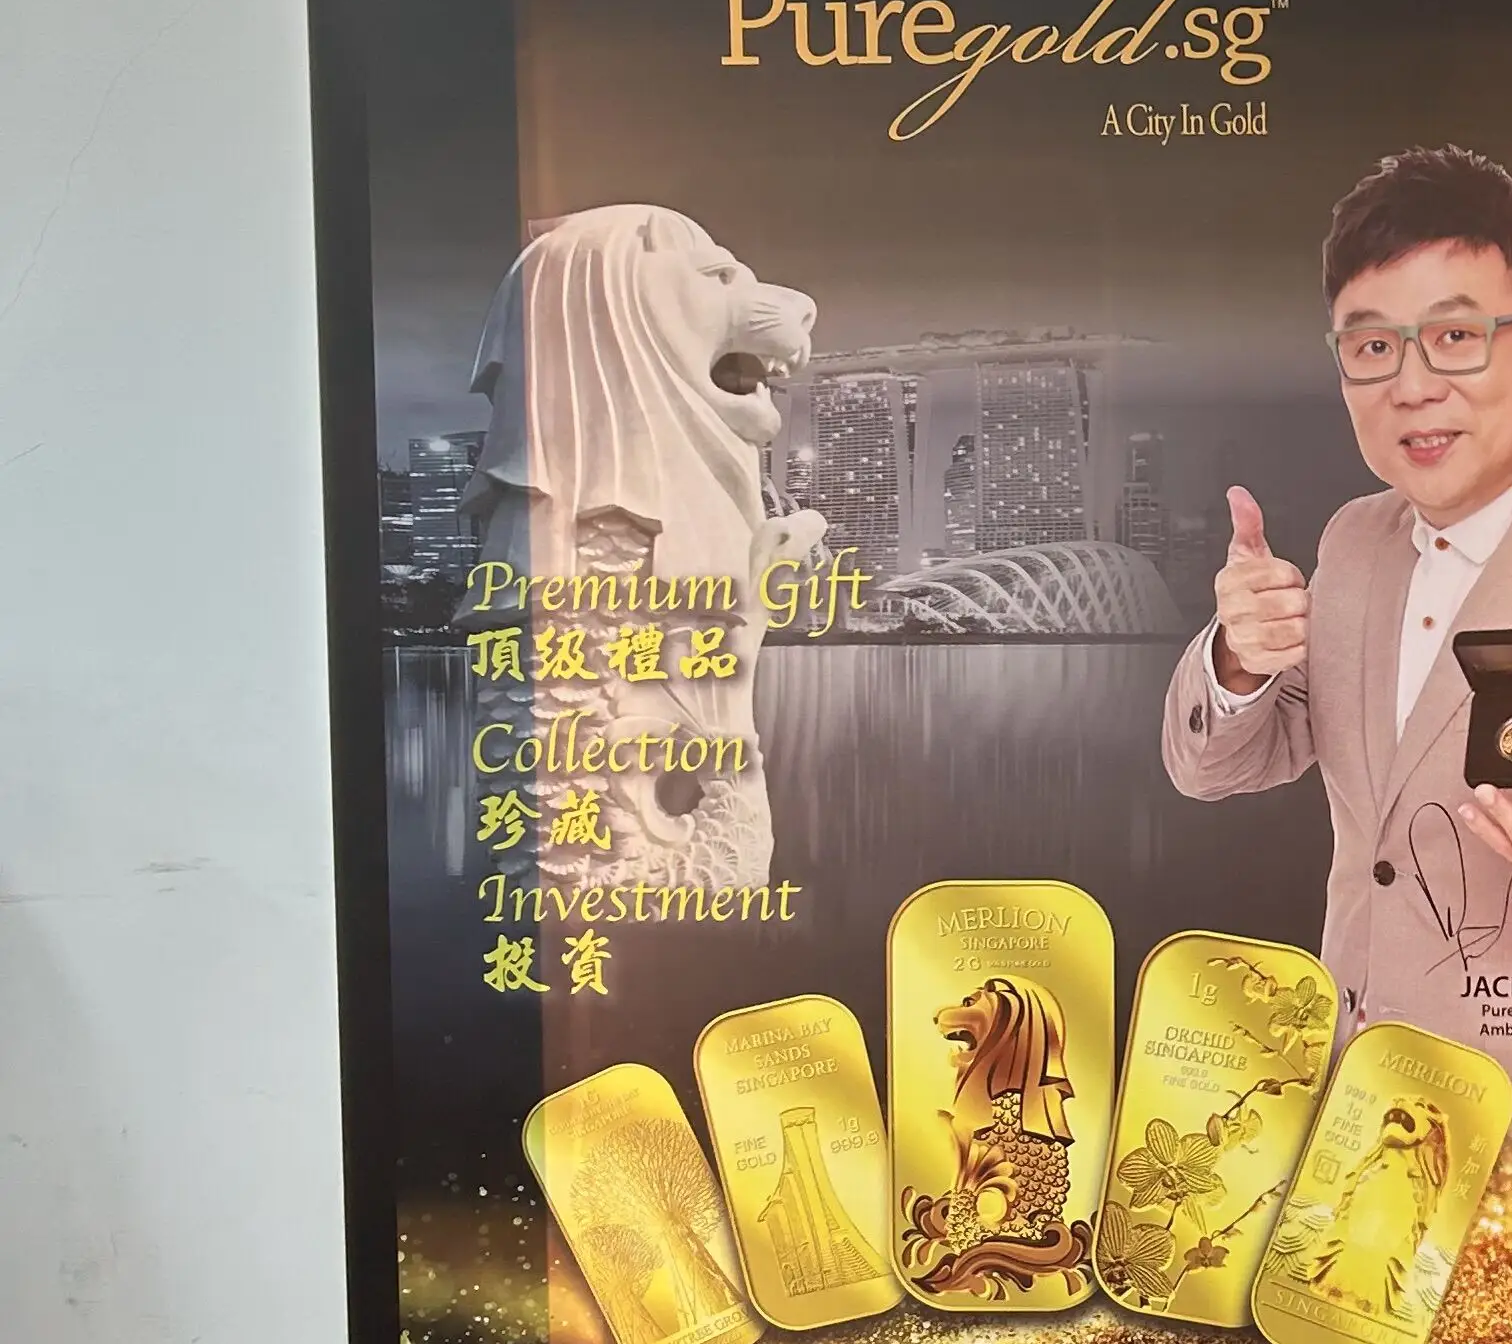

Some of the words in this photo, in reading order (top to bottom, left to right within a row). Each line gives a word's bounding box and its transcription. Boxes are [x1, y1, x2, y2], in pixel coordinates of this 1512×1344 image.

[1101, 104, 1123, 136] A
[1126, 103, 1175, 146] City
[1180, 103, 1205, 136] In
[1209, 101, 1268, 136] Gold
[467, 558, 737, 612] Premium
[760, 547, 873, 638] Gift
[467, 626, 737, 683] 頂級禮品
[472, 710, 748, 774] Collection
[476, 789, 612, 850] 珍藏
[478, 873, 802, 922] Investment
[937, 905, 1072, 937] MERLION
[960, 936, 1050, 950] SINGAPORE
[483, 929, 612, 994] 投資
[1188, 971, 1218, 1006] 1g
[724, 1027, 795, 1055] MARINA
[800, 1017, 832, 1037] BAY
[1165, 1026, 1236, 1050] ORCHID
[754, 1044, 811, 1069] SANDS
[1144, 1040, 1248, 1072] SINGAPORE
[736, 1058, 839, 1095] SINGAPORE
[1379, 1049, 1489, 1104] MERLION
[838, 1117, 860, 1133] 1g
[1325, 1130, 1361, 1152] GOLD
[1333, 1116, 1364, 1136] FINE
[734, 1136, 767, 1154] FINE
[830, 1130, 880, 1154] 999.9
[736, 1152, 777, 1171] GOLD
